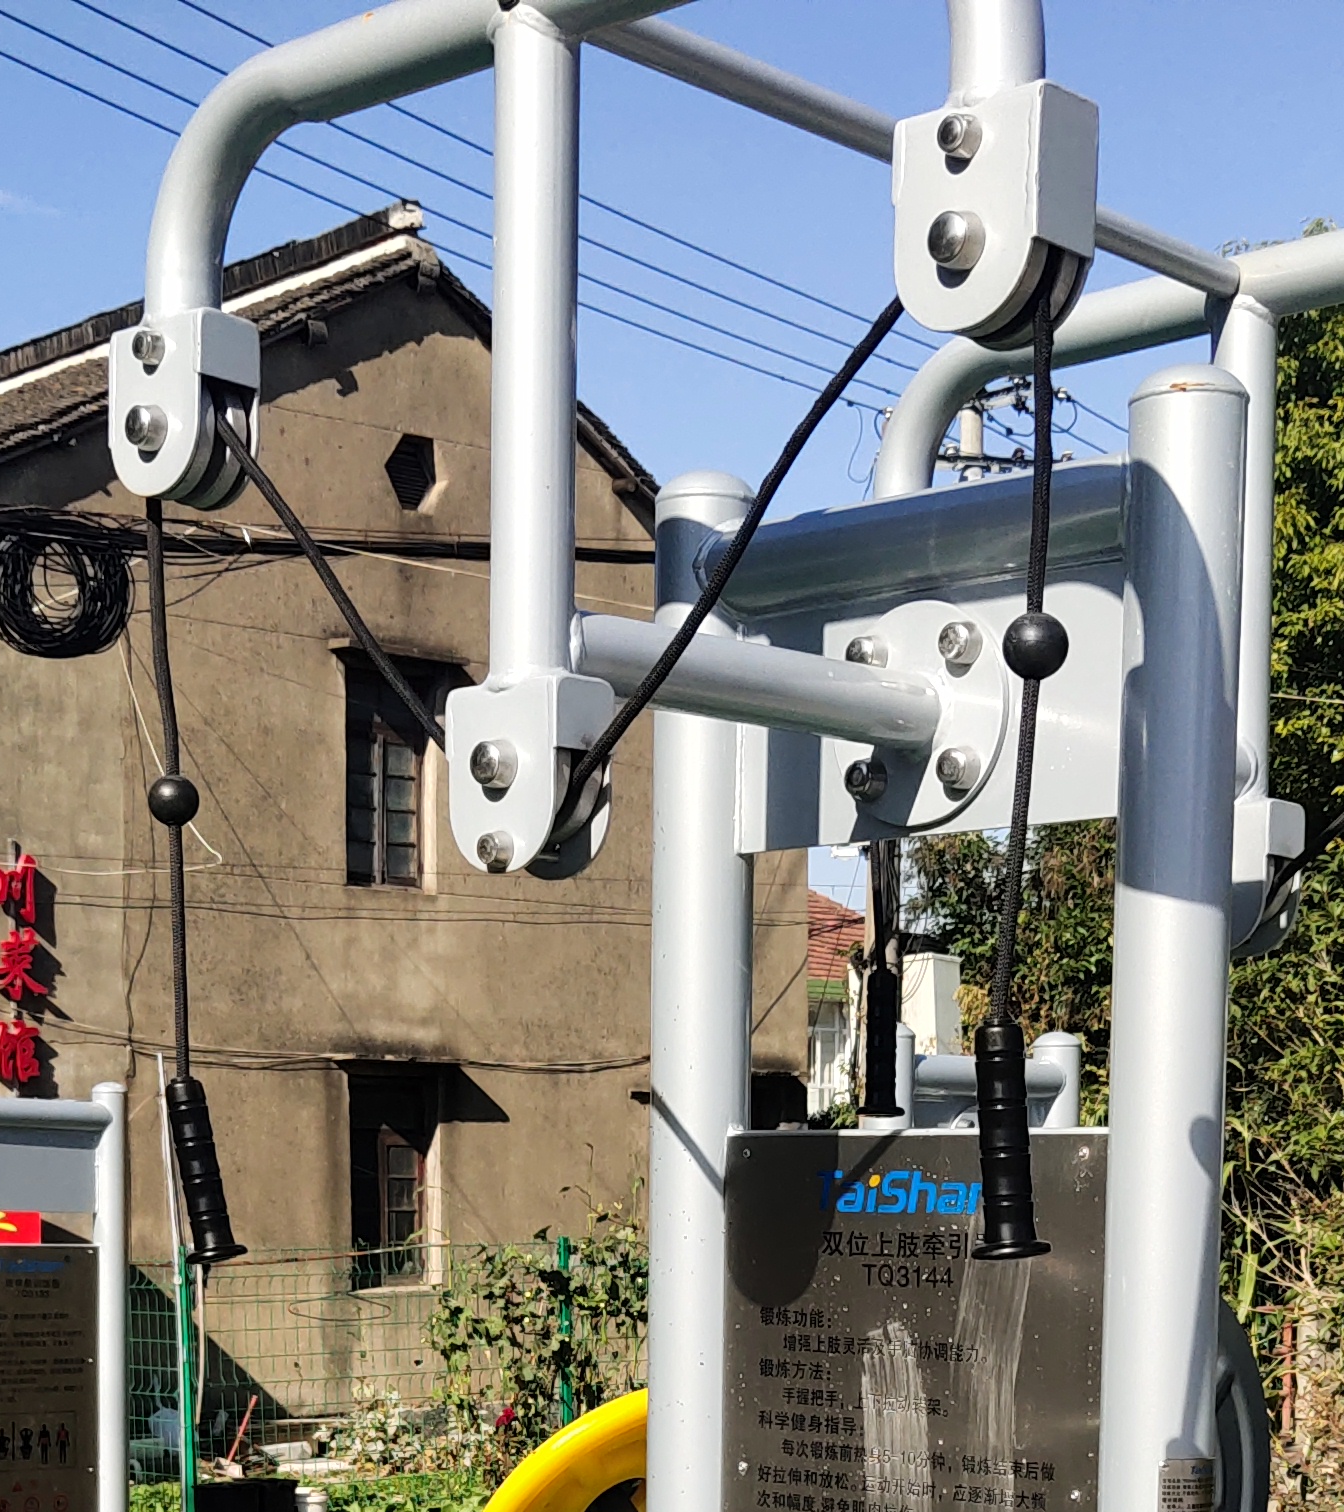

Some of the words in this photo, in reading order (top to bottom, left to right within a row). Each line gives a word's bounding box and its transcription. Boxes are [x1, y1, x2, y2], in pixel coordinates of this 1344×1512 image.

[822, 1230, 986, 1261] 双位上肢牵引
[861, 1263, 954, 1289] TQ3144
[760, 1306, 833, 1330] 锻炼功能：
[759, 1358, 832, 1382] 锻炼方法：
